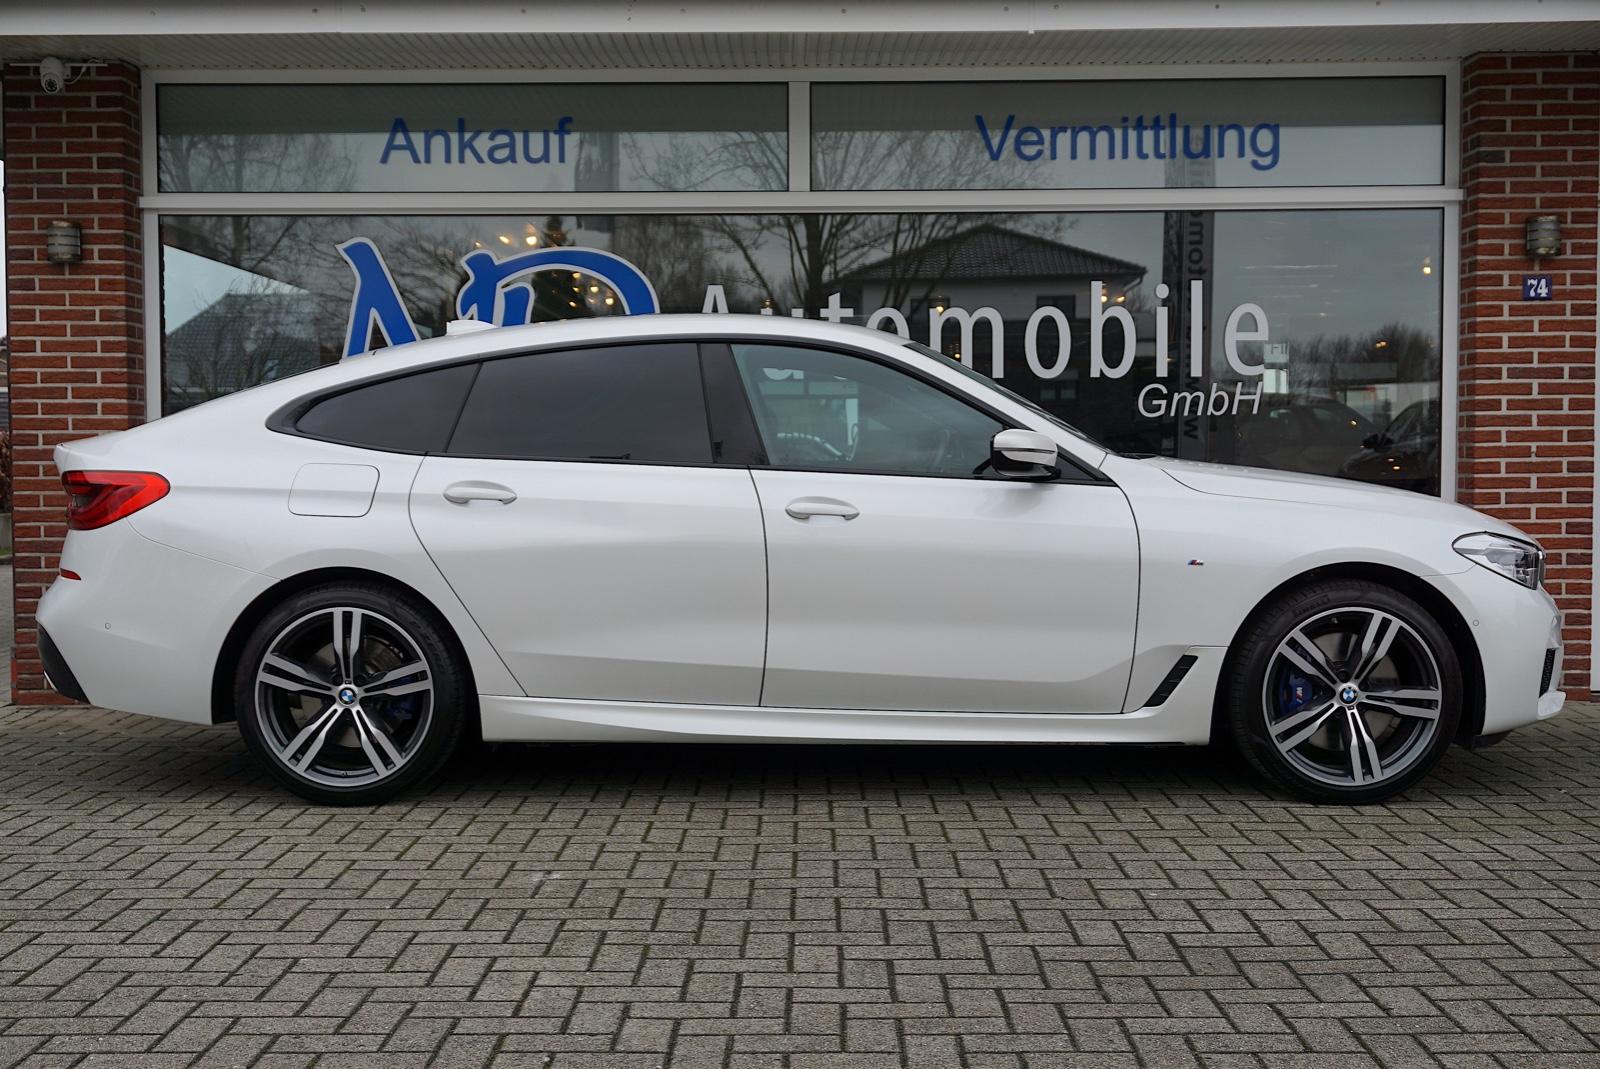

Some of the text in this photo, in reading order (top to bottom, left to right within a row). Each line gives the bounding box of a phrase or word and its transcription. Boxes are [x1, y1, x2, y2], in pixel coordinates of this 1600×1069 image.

[380, 117, 573, 164] Ankauf
[975, 112, 1280, 171] Vermittlung
[1527, 278, 1549, 297] 74
[702, 280, 1269, 379] mobile
[1137, 382, 1263, 418] GmbH
